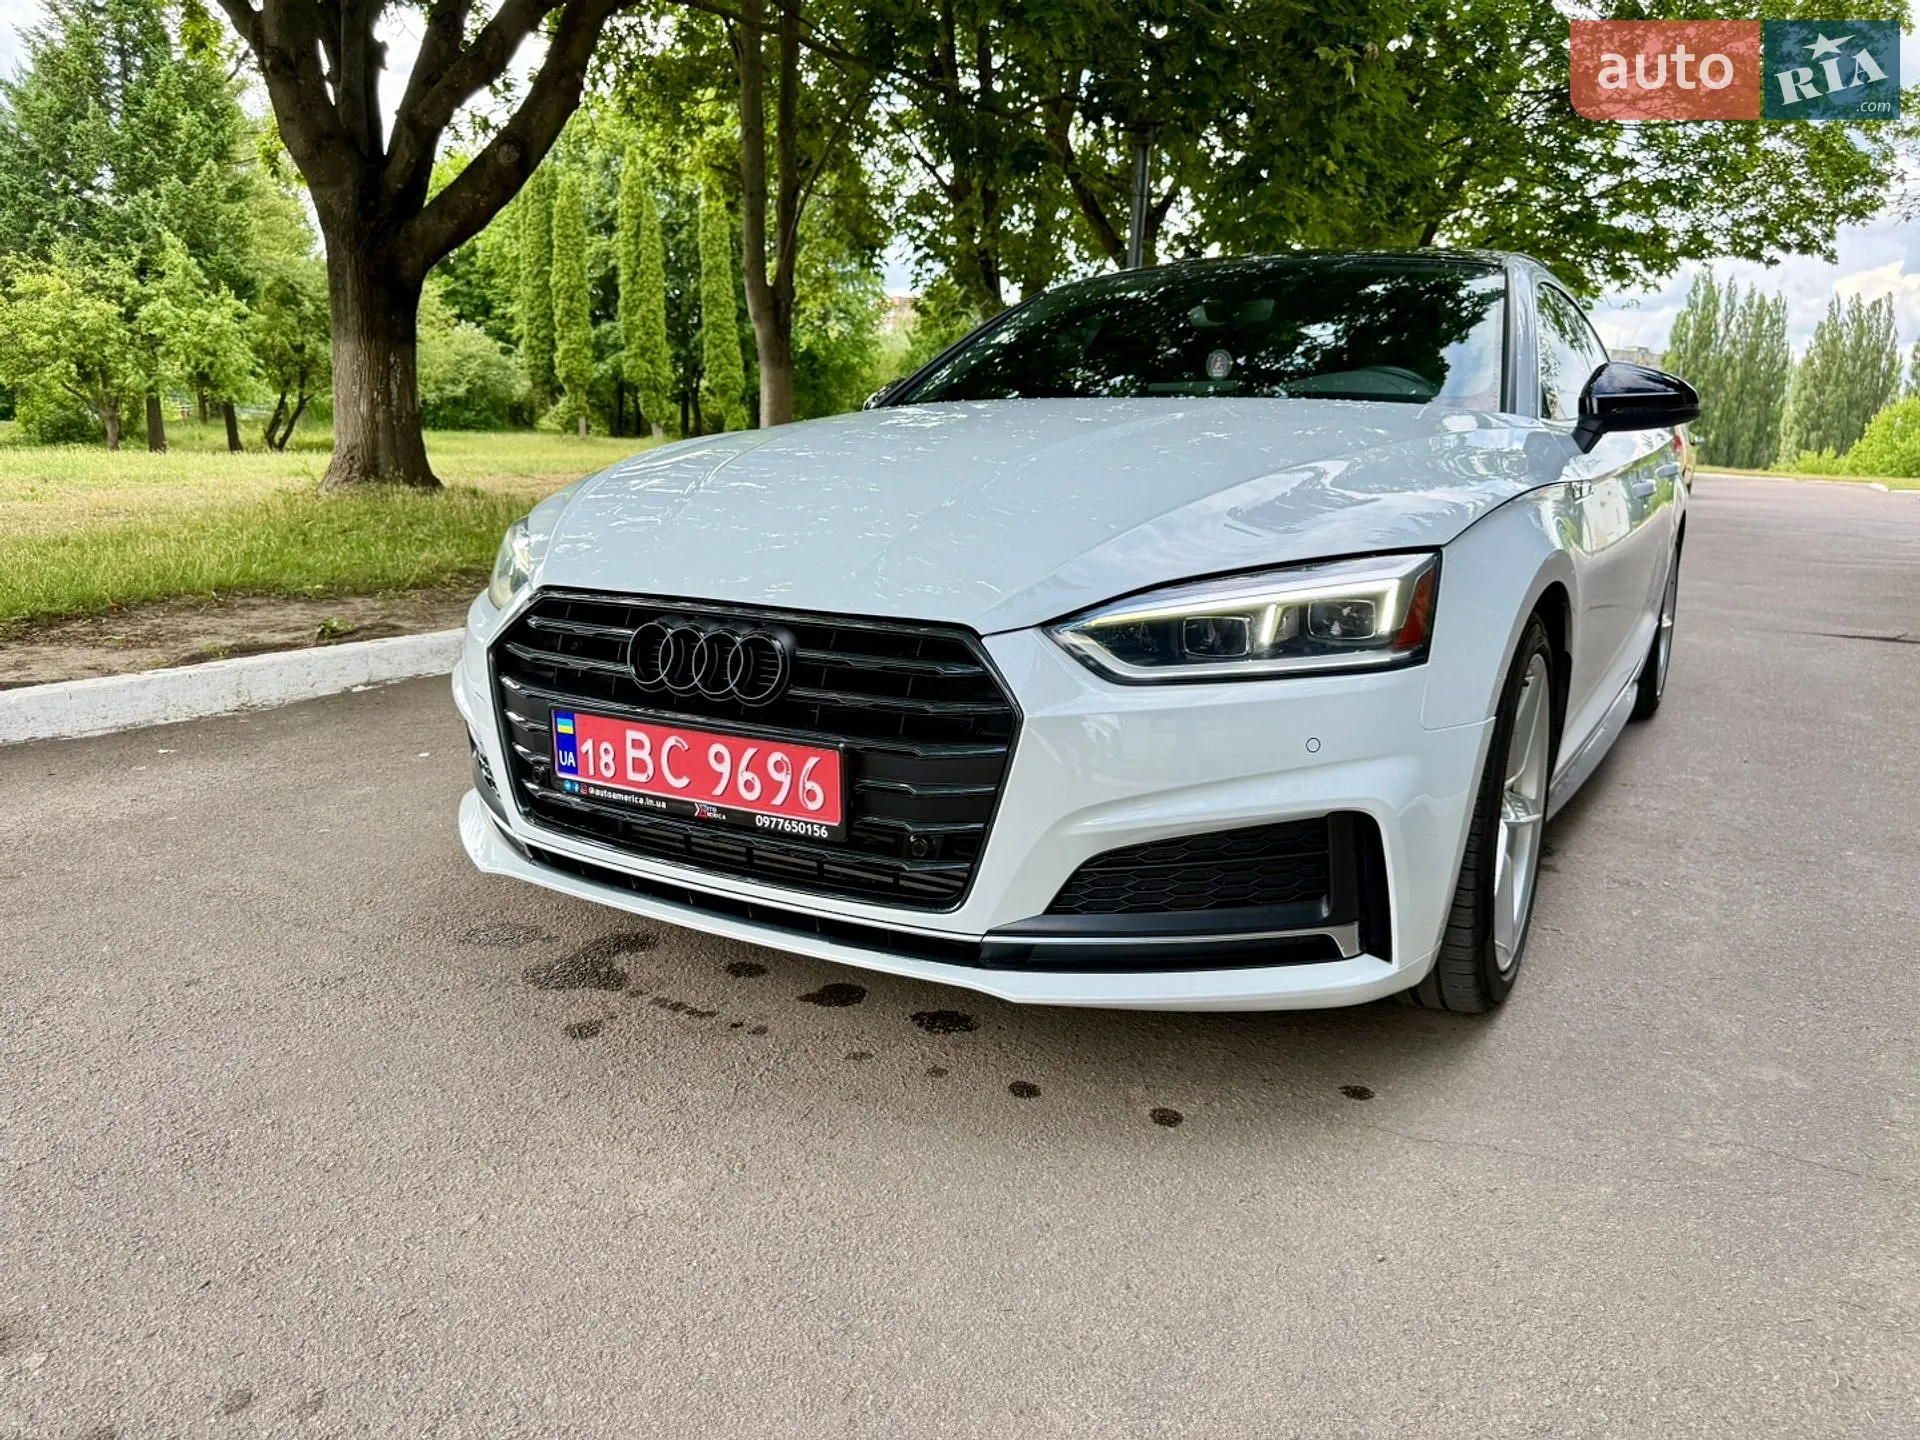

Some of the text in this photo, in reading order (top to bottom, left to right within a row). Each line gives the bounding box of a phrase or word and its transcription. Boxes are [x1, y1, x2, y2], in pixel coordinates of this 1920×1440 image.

[559, 749, 576, 766] UA
[580, 729, 824, 811] 18 BC 9696
[588, 787, 667, 808] @autoamerica.in.ua
[755, 814, 828, 838] 0977650156
